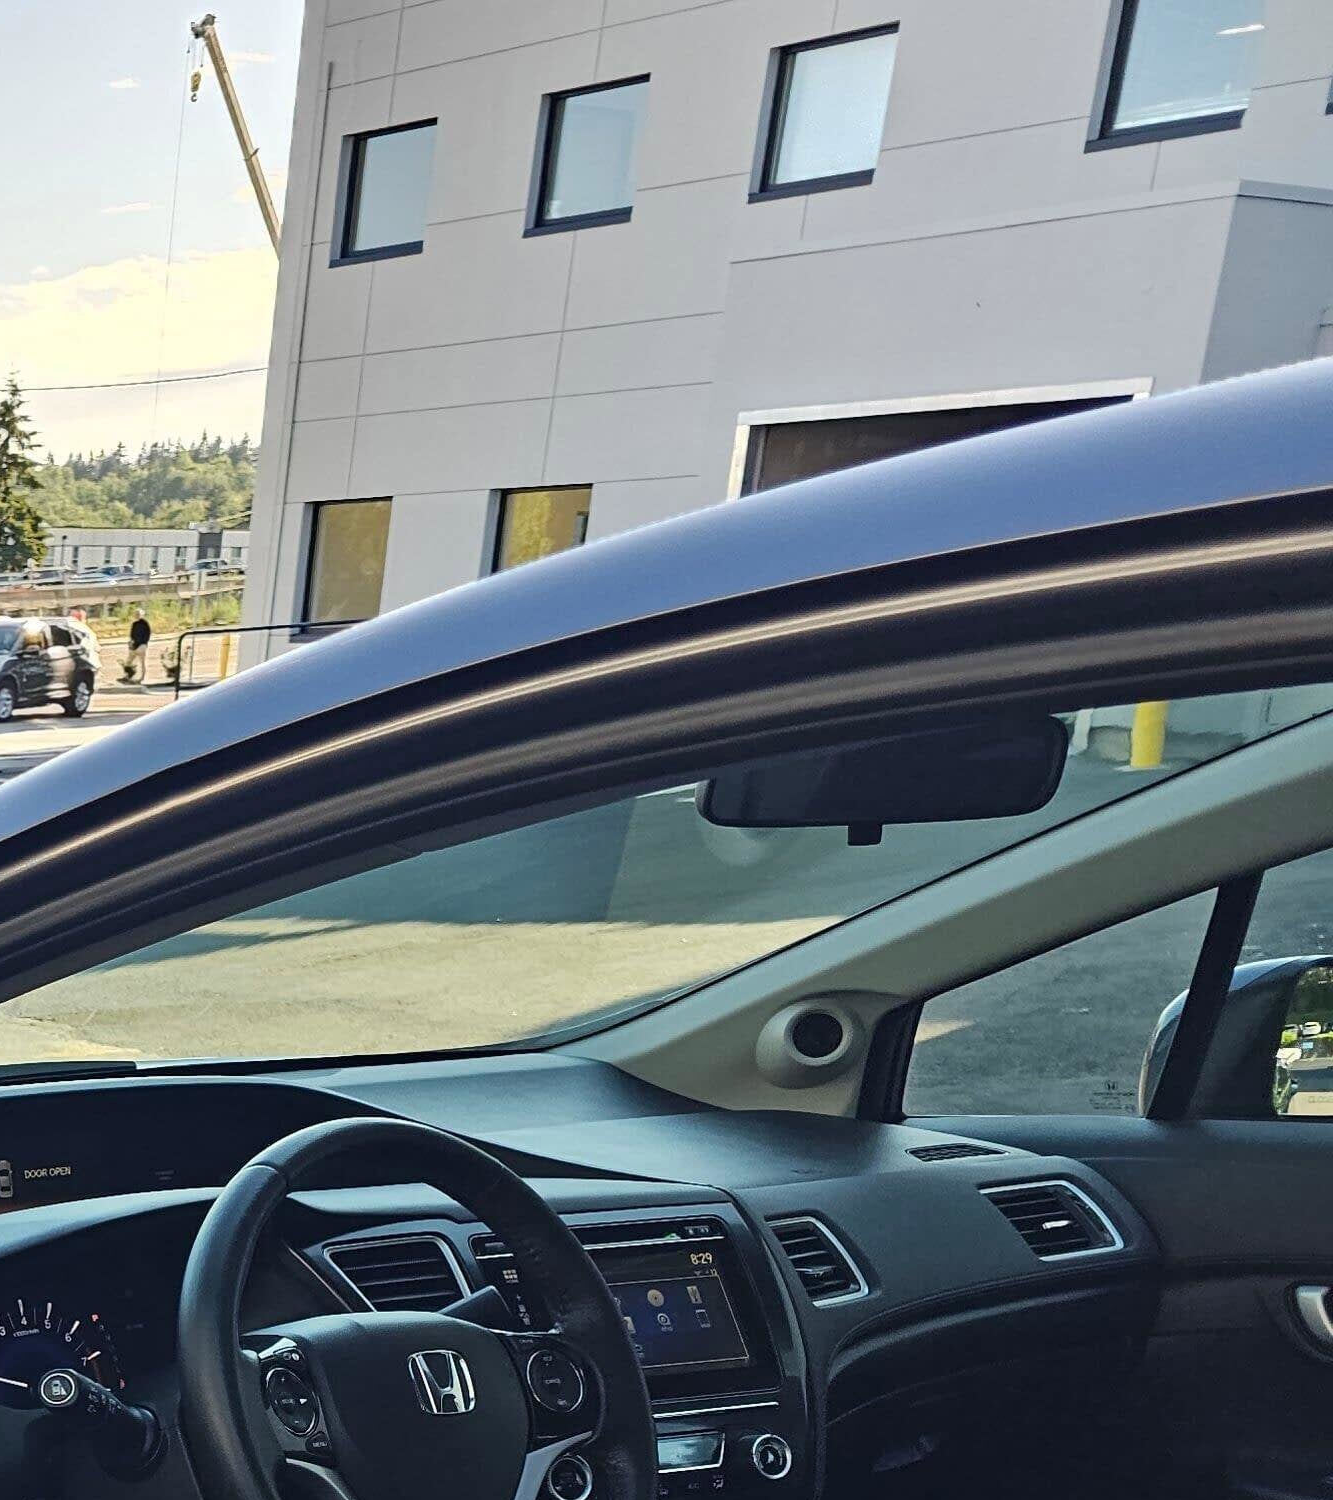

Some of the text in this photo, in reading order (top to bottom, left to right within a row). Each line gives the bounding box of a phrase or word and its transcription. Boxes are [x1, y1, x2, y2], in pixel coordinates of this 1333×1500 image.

[24, 1166, 71, 1179] DOOR OPEN
[690, 1252, 713, 1265] 8:29
[20, 1316, 28, 1326] 4
[44, 1319, 52, 1330] 5
[64, 1332, 73, 1343] 6
